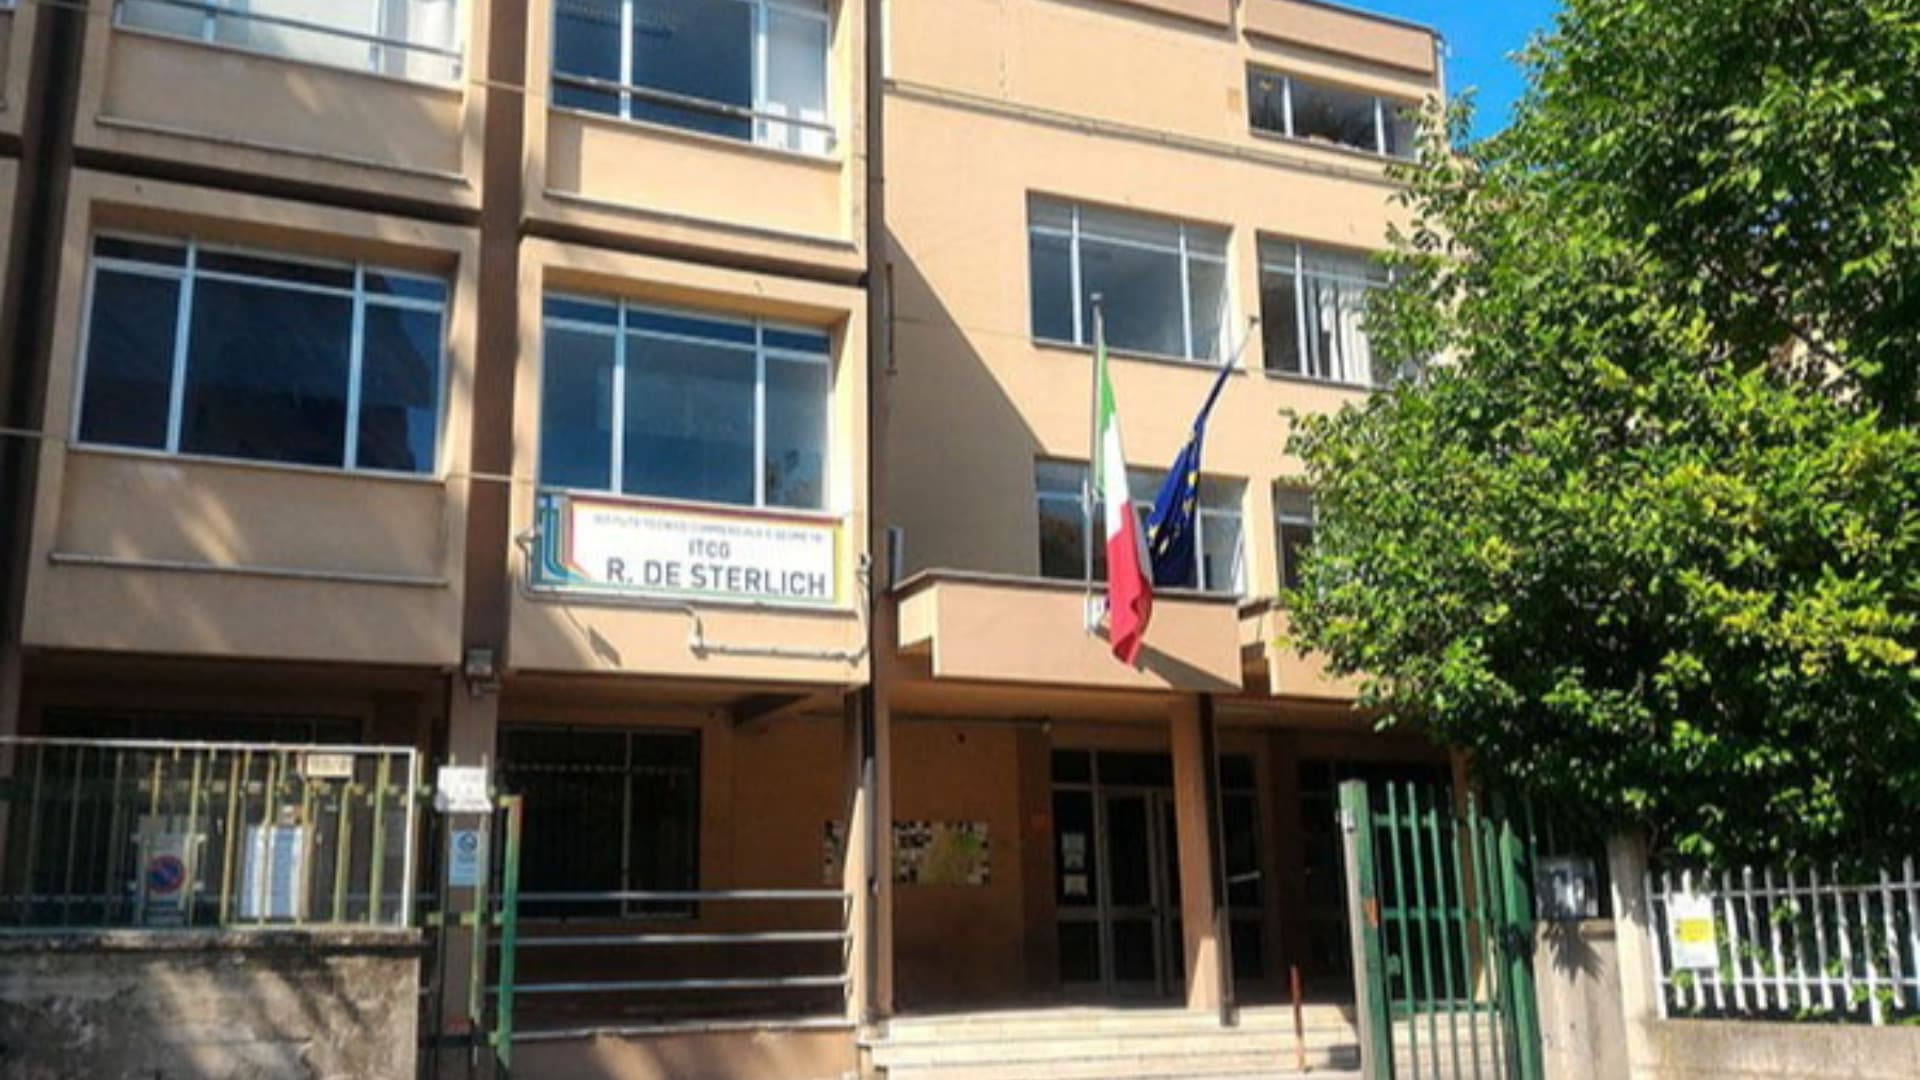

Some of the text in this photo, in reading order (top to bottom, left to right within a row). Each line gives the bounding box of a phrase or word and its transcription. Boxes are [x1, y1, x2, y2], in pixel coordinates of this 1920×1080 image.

[606, 556, 826, 596] R. DE STERLICH
